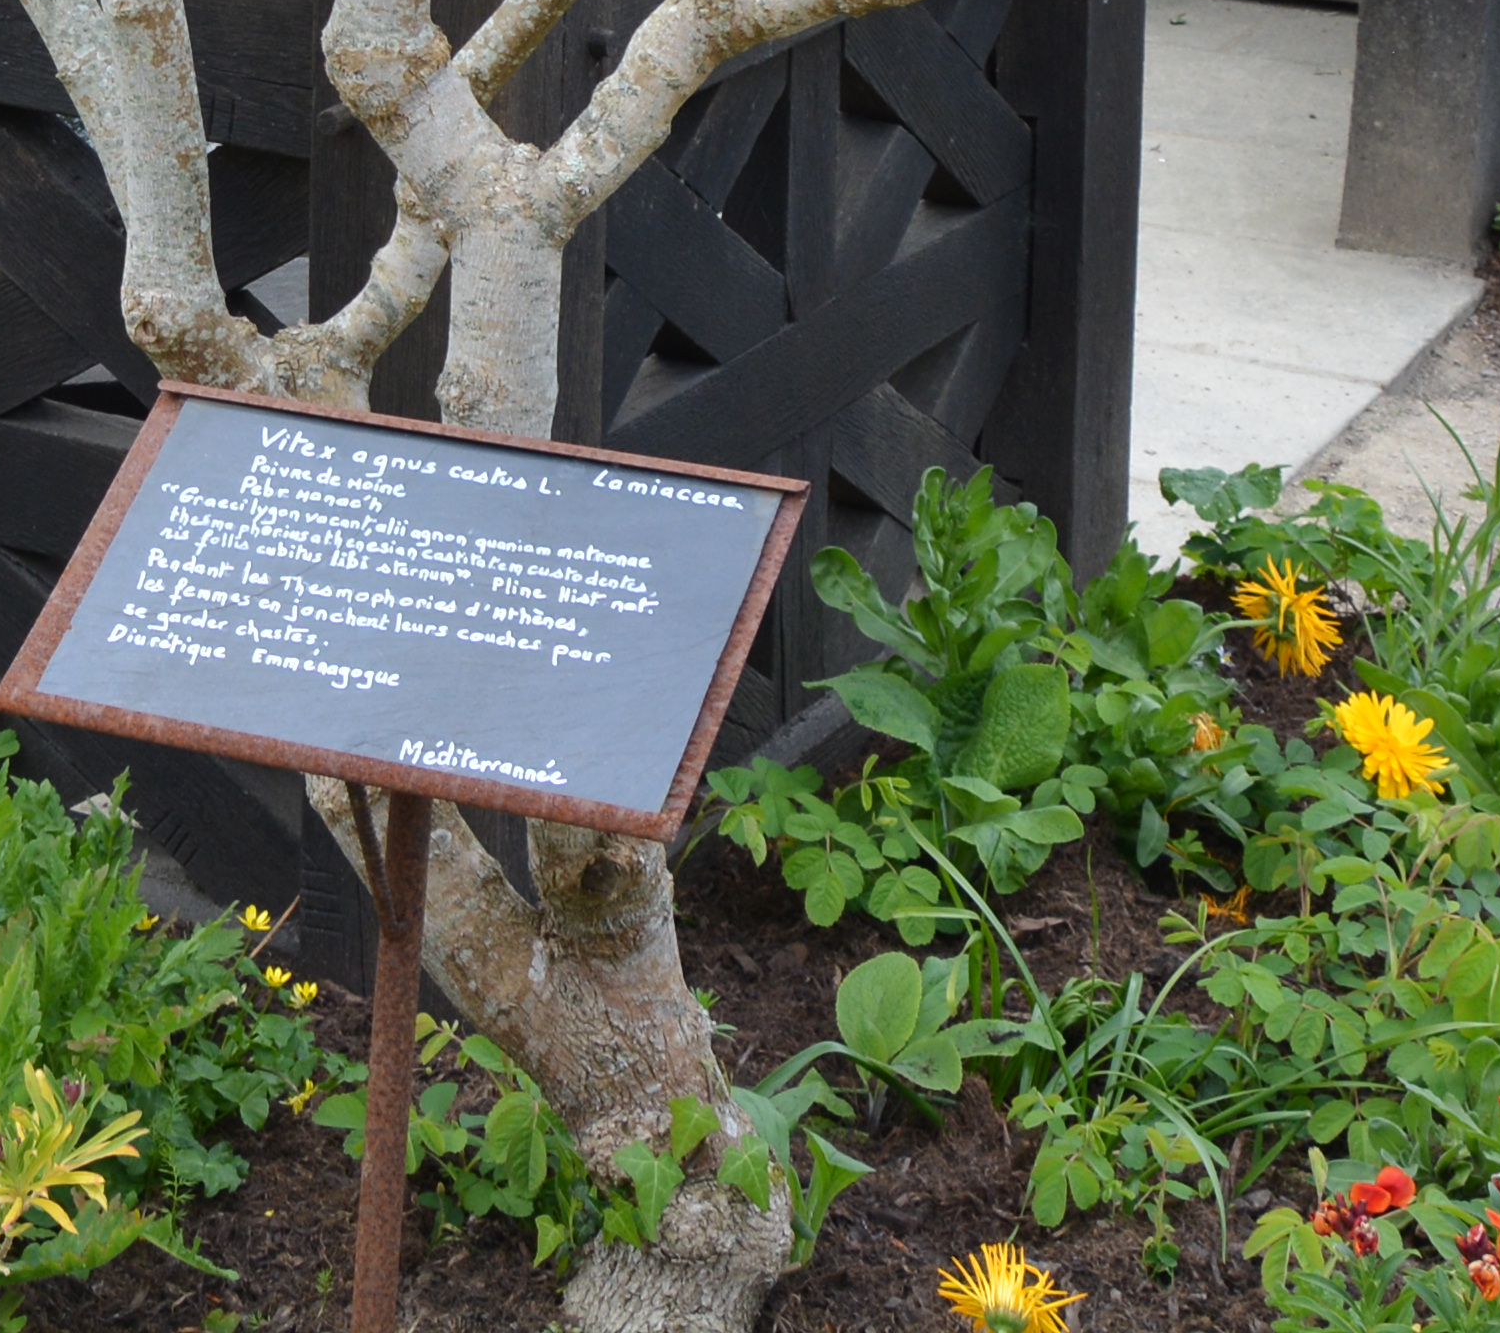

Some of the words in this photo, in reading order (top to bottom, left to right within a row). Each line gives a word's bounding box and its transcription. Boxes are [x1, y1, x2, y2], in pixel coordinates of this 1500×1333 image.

[251, 455, 312, 482] Poivre
[316, 466, 341, 487] de
[262, 427, 336, 460] Vitex
[352, 450, 437, 478] agnus
[449, 466, 527, 490] castus
[539, 477, 562, 496] L.
[592, 469, 744, 510] Lamiaceae
[148, 547, 235, 579] Pendant
[241, 560, 270, 585] les
[410, 529, 468, 548] agnon
[556, 544, 653, 569] matronae
[491, 576, 547, 600] Pline
[123, 602, 148, 620] se
[147, 608, 229, 632] garder
[235, 619, 330, 648] chastes.
[136, 569, 165, 593] les
[168, 577, 252, 607] femmes
[258, 597, 282, 614] en
[283, 597, 391, 631] jonchent
[394, 612, 449, 638] leurs
[456, 627, 544, 651] couches
[551, 643, 612, 667] pour
[107, 623, 227, 666] Diurétique
[251, 647, 401, 690] Emménagogue
[398, 738, 568, 786] Méditerrannée
